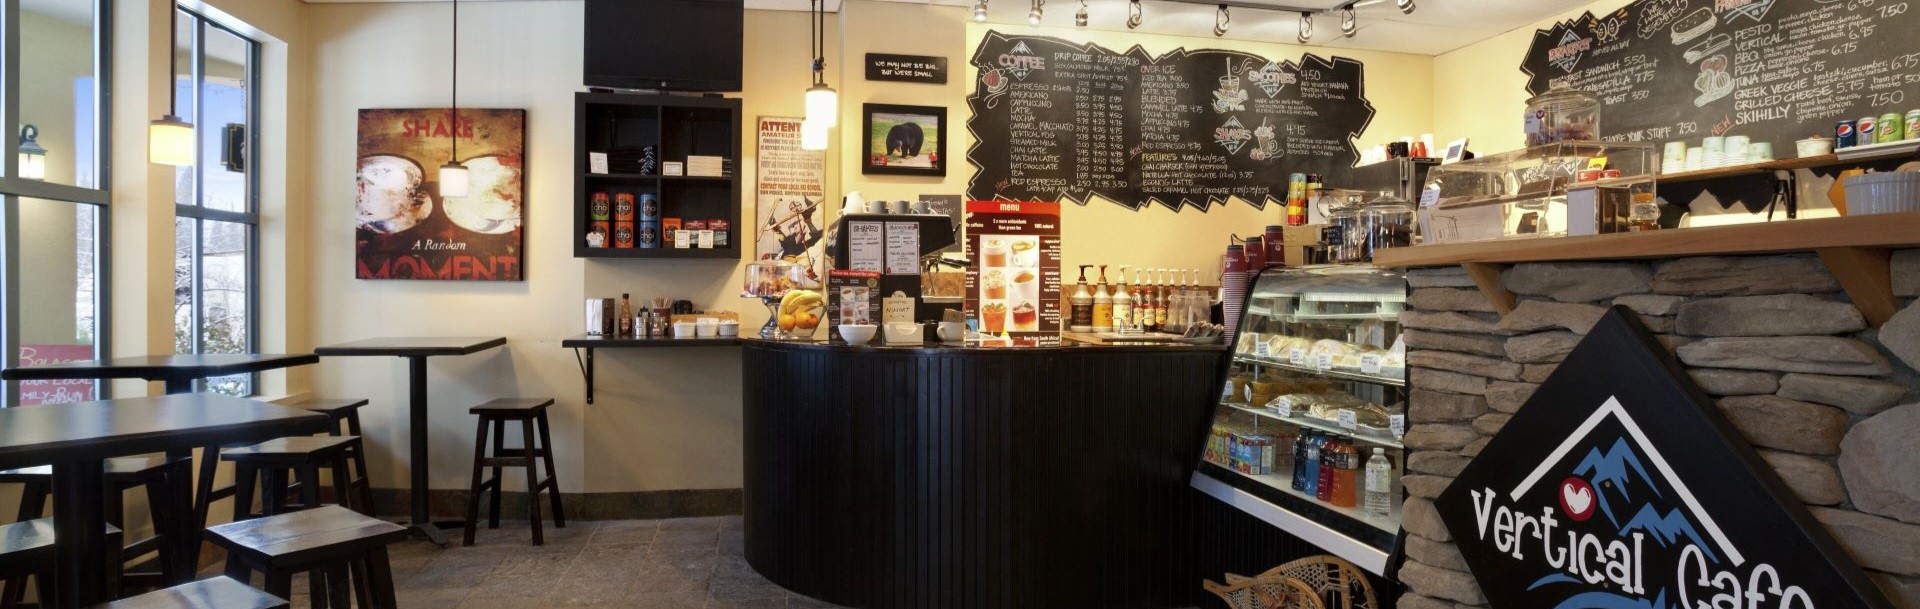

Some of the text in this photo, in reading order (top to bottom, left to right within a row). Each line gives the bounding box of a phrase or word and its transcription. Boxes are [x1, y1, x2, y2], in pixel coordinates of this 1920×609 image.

[1647, 2, 1659, 15] WE
[1875, 2, 1908, 19] 7.50
[1645, 8, 1665, 24] HAVE
[1735, 24, 1772, 41] PESTO
[1849, 24, 1877, 40] 6.95
[1735, 33, 1786, 51] VERTICAL
[1831, 42, 1858, 55] 6.75
[999, 54, 1045, 69] COFFEE
[1055, 52, 1071, 61] DRIP
[1072, 54, 1092, 62] COFFEE
[1735, 50, 1760, 65] BBQ
[1891, 53, 1920, 70] 6.75
[887, 62, 900, 70] MAY
[1141, 65, 1176, 74] OVER ICE
[1585, 60, 1621, 78] SANDWICH
[1735, 61, 1766, 76] PIZZA
[1802, 60, 1827, 73] 6.75
[1300, 70, 1321, 80] 4.50
[1736, 74, 1759, 89] TUNA
[1735, 78, 1808, 100] GREEK VEGGIE
[1870, 82, 1901, 91] tomato
[1010, 91, 1048, 100] AMERICANO
[1141, 95, 1177, 104] BLENDED
[1604, 93, 1628, 105] TOAST
[1734, 79, 1865, 110] GRILLED CHEESE 5.75
[1866, 90, 1904, 107] 7.50
[1010, 99, 1052, 108] CAPPUCCINO
[1736, 104, 1791, 124] SKIHILLY
[402, 117, 474, 138] SHARE
[761, 121, 802, 132] ATTENT
[1039, 122, 1074, 131] MACCHIATO
[1141, 118, 1177, 126] CAPPUCCINO
[1711, 114, 1732, 137] NEW
[1141, 132, 1164, 140] MATCHA
[1626, 131, 1645, 142] YOUR
[1646, 126, 1671, 140] STUFF
[1142, 140, 1185, 150] RED ESPRESSO
[1011, 154, 1037, 162] MATCHA
[1142, 153, 1177, 161] FEATURES
[1000, 203, 1019, 211] menu
[854, 224, 878, 232] SHAKES
[412, 239, 466, 250] A Random
[358, 255, 518, 280] MOMENT
[1471, 487, 1645, 596] Vertical
